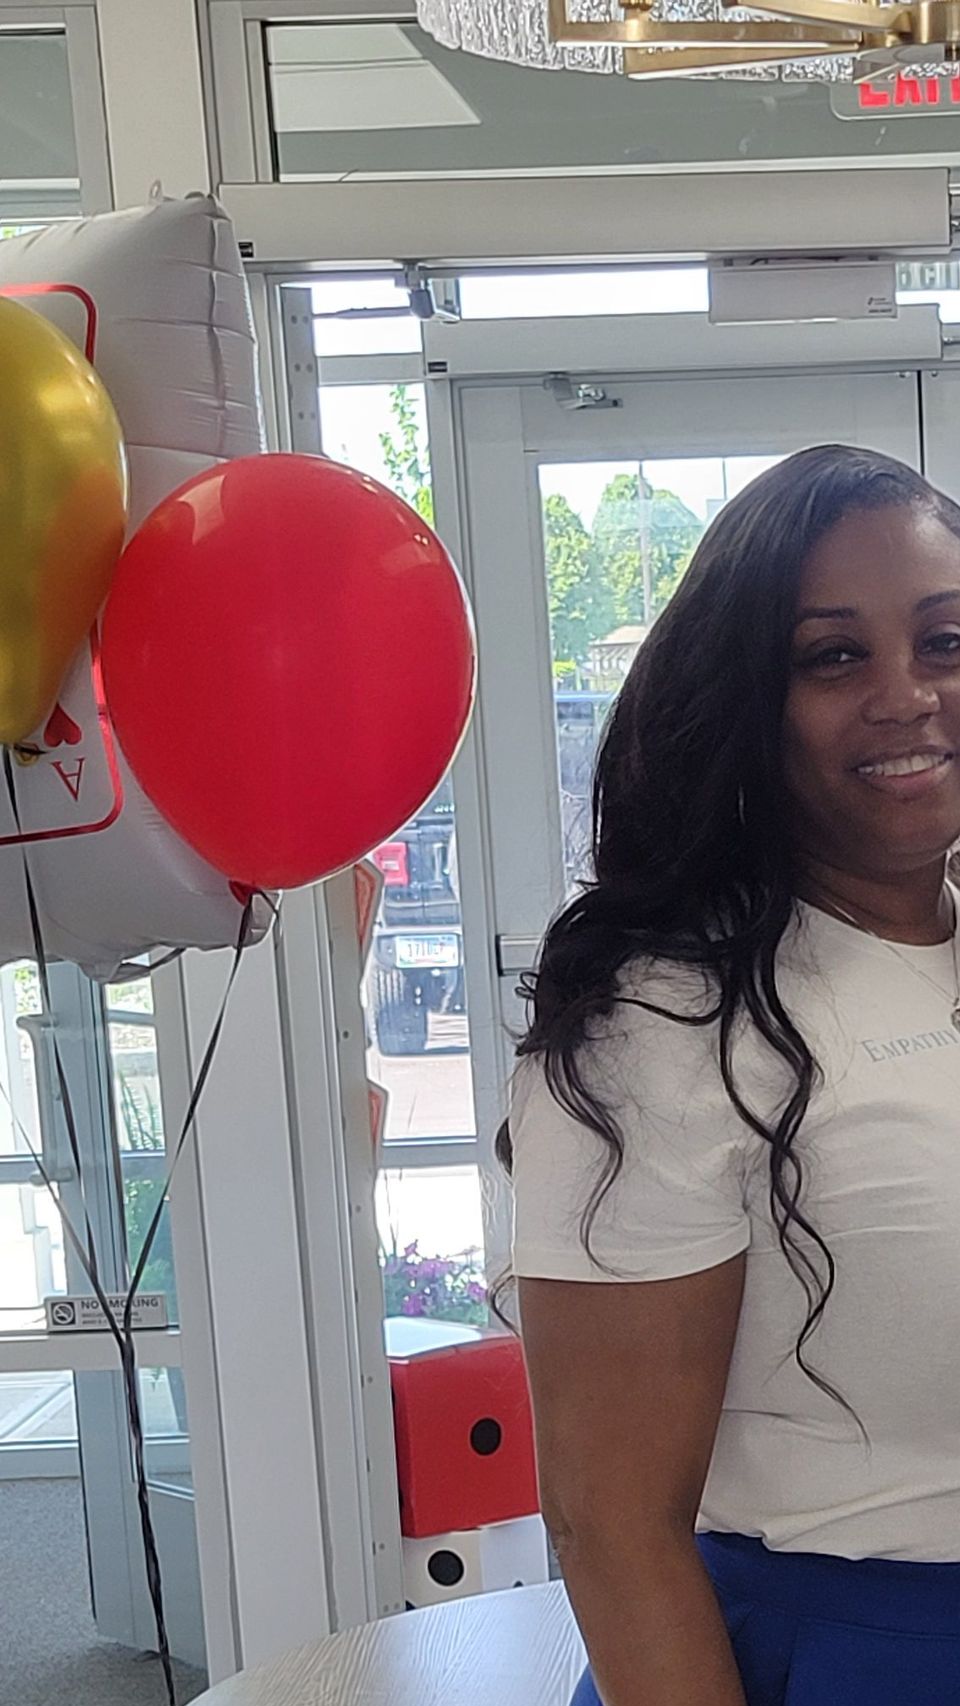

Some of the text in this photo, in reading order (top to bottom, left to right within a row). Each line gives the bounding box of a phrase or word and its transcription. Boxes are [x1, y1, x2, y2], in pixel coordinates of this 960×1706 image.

[51, 757, 85, 802] A
[81, 1297, 159, 1310] NO MOING
